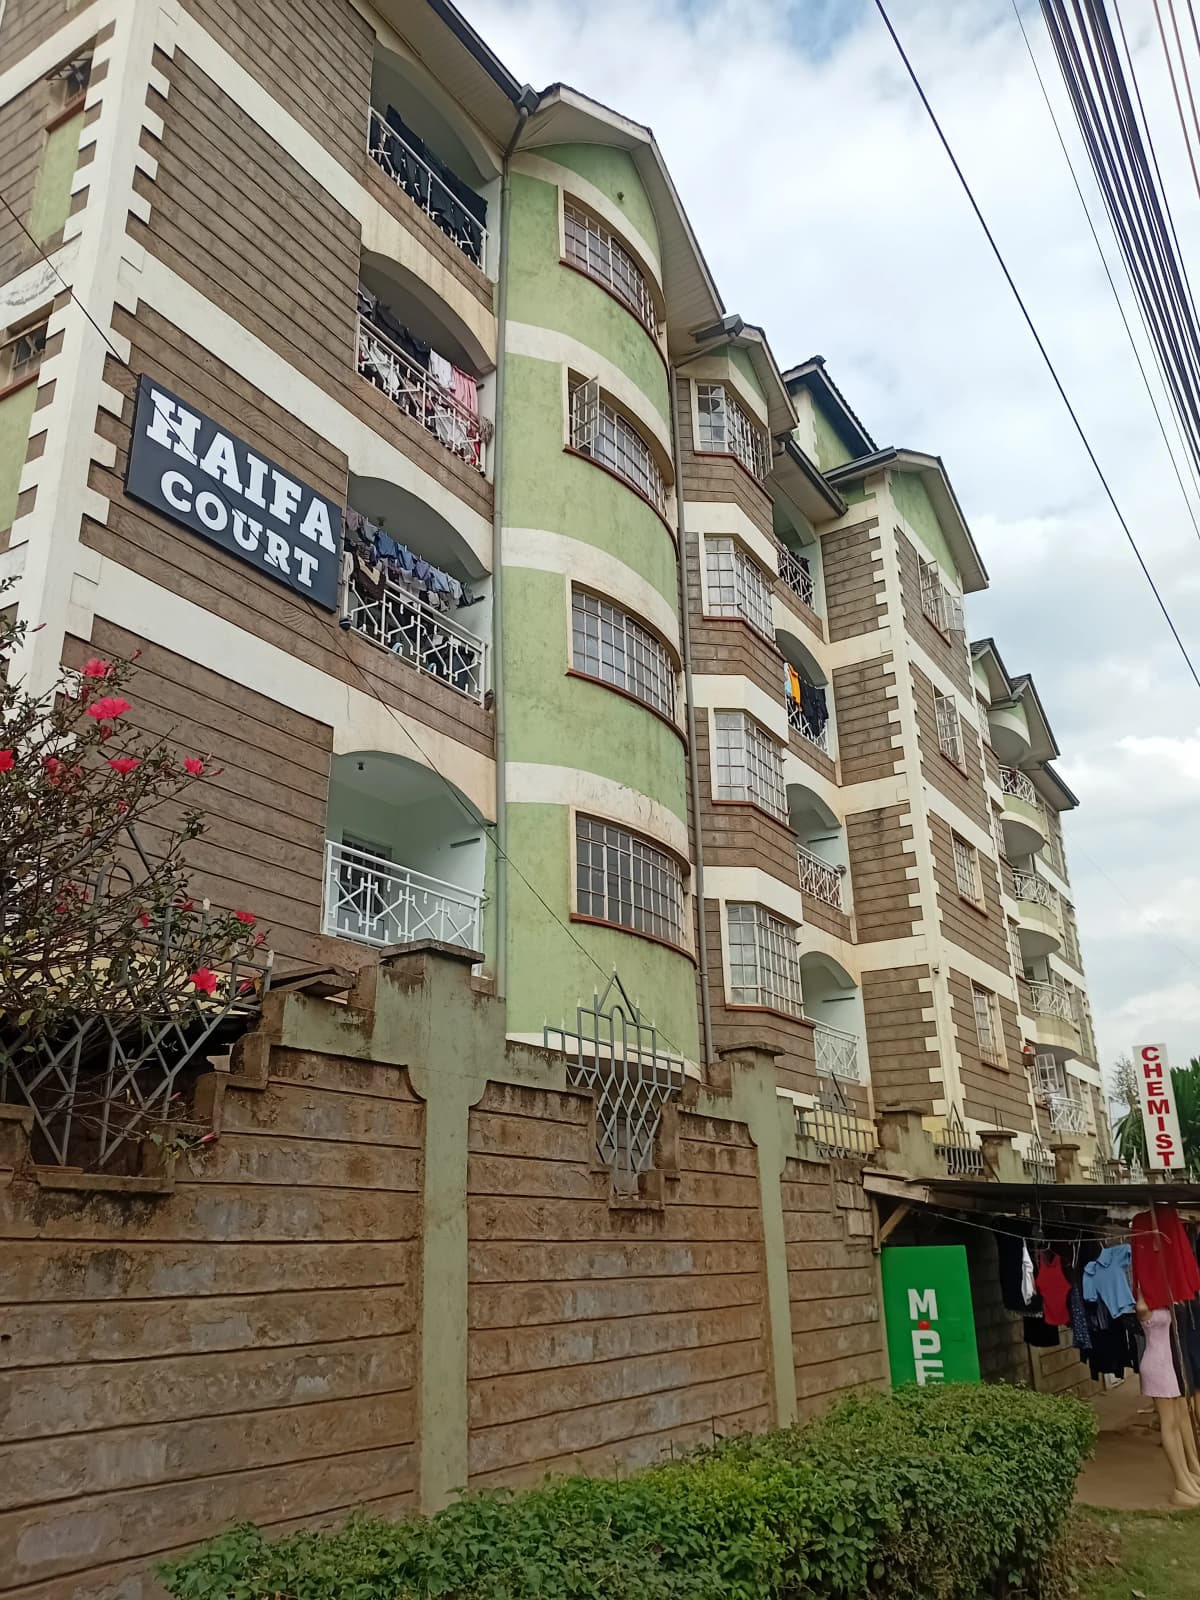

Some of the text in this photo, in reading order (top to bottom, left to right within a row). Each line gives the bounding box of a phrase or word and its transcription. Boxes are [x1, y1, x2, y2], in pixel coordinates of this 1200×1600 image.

[147, 388, 336, 554] HAIFA
[161, 470, 319, 588] COURT
[1141, 1046, 1175, 1167] CHEMIST
